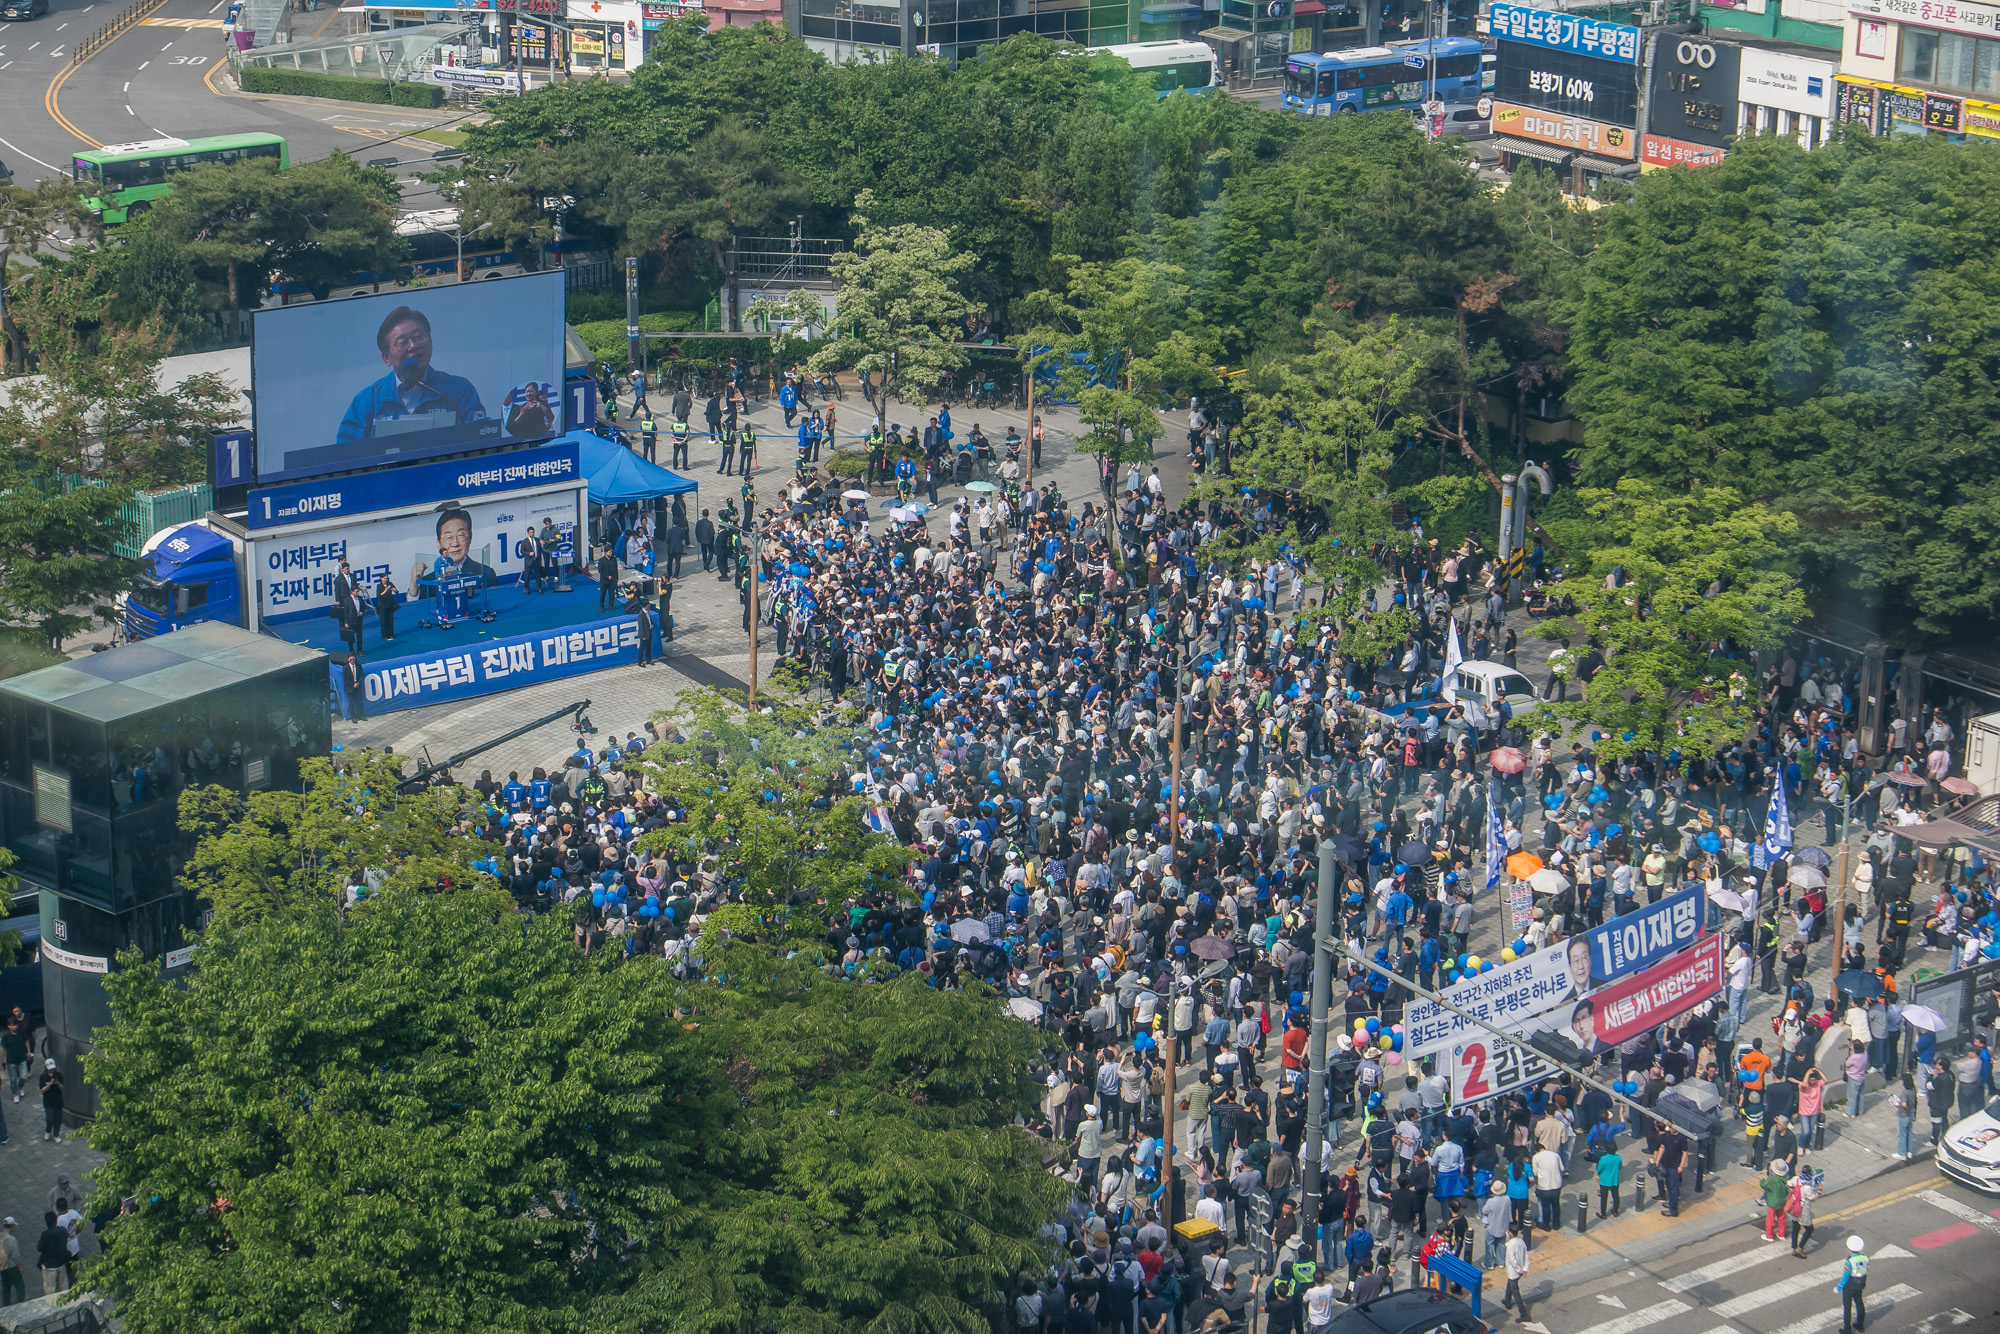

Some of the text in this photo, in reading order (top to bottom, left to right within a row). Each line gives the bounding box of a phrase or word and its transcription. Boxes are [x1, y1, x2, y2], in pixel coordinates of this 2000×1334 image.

[1884, 0, 1918, 15] 새것같은
[1920, 1, 1957, 23] 중고폰
[1959, 10, 1993, 27] 사고팔기
[1493, 8, 1636, 58] 독일보청기 부평점
[168, 56, 208, 65] 30
[1529, 70, 1594, 102] 보청기 60%
[1523, 116, 1599, 150] 마미치킨
[1929, 111, 1955, 126] 호프
[1646, 140, 1672, 161] 앞선
[573, 387, 585, 424] 1
[227, 440, 240, 479] 1
[458, 458, 573, 488] 이제부터 진짜 대한민국
[262, 493, 341, 519] 1 지금은 이재명
[268, 540, 347, 574] 이제부터
[497, 532, 508, 563] 1
[269, 563, 392, 606] 진짜 대민국
[365, 621, 641, 702] 이제부터 진짜 대한민국
[1597, 896, 1697, 976] 1 이재명
[1613, 929, 1625, 970] 지금은
[1452, 984, 1482, 1008] 전구간
[1483, 974, 1512, 996] 지하화
[1514, 964, 1533, 984] 추진
[1603, 957, 1714, 1031] 새롭게 대한민국!
[1410, 1020, 1450, 1048] 철도는
[1494, 986, 1531, 1015] 부평은
[1532, 972, 1568, 1001] 하나로
[1461, 1042, 1490, 1100] 2
